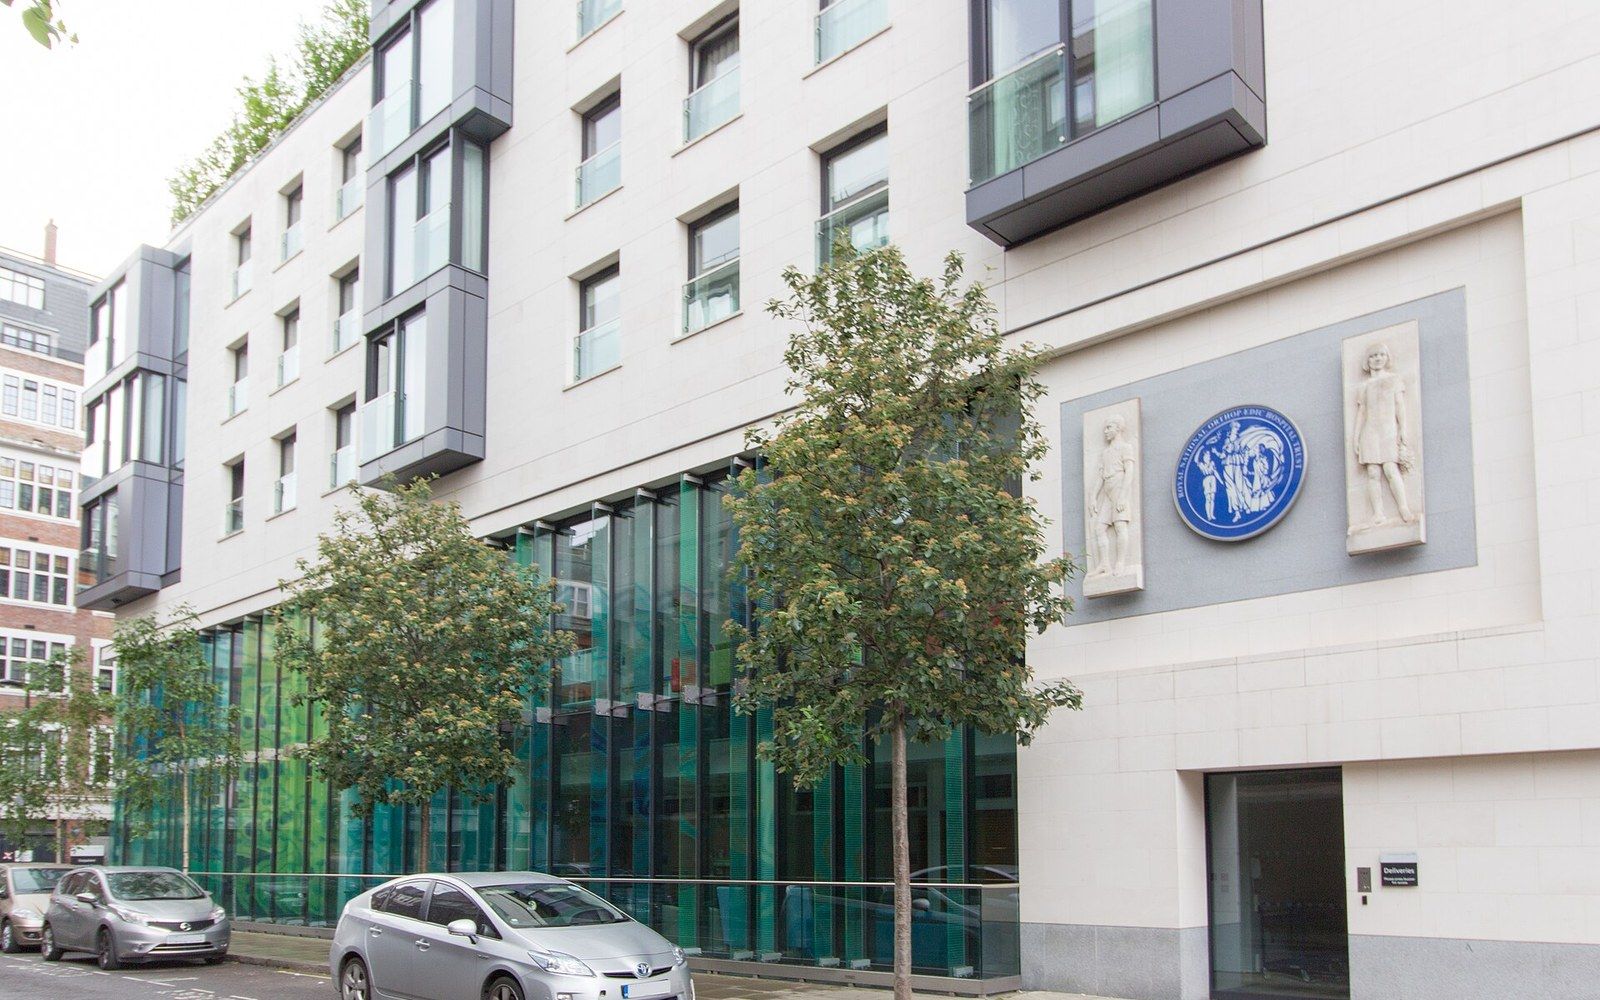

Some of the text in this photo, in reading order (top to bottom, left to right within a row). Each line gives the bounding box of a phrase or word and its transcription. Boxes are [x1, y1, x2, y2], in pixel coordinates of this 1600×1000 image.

[1265, 411, 1297, 442] HOSPITAL
[1180, 430, 1208, 468] NATIONAL
[1293, 441, 1302, 469] TRUST
[1177, 472, 1185, 498] ROYAL
